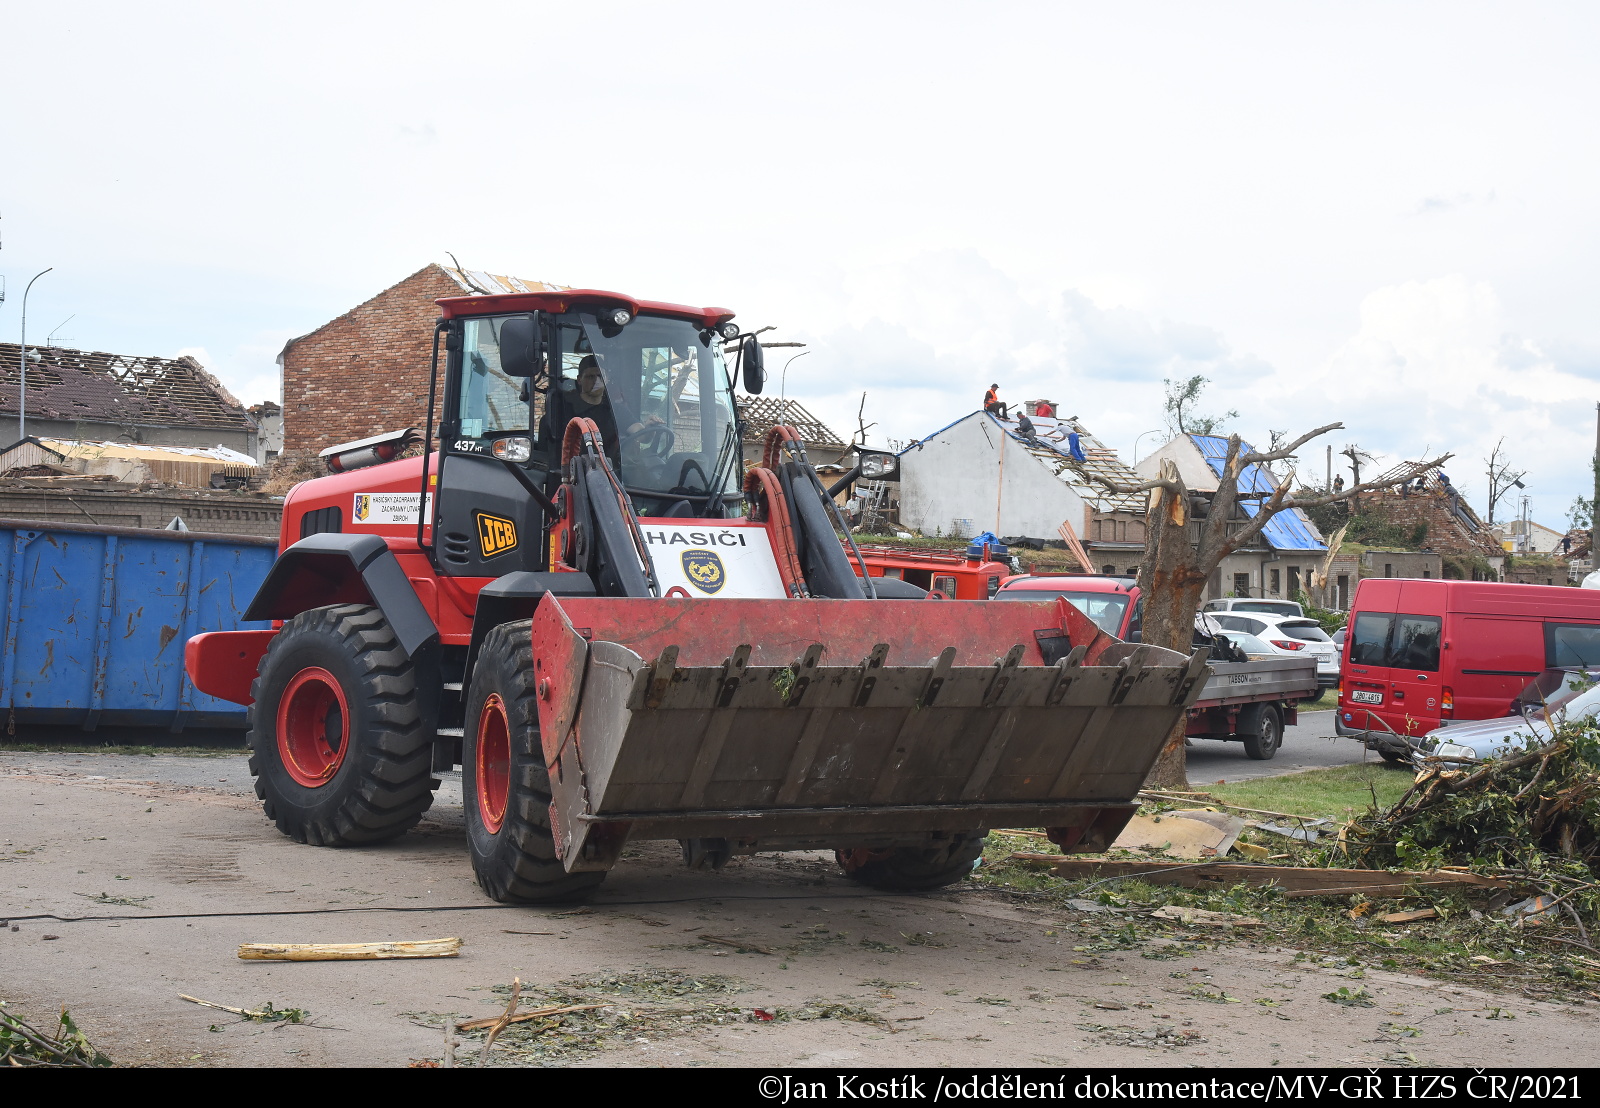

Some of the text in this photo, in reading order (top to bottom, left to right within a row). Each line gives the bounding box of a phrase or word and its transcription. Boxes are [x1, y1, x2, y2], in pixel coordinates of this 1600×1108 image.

[392, 514, 409, 522] ZBIROH
[483, 519, 514, 552] JCB
[645, 530, 747, 547] HASIČI
